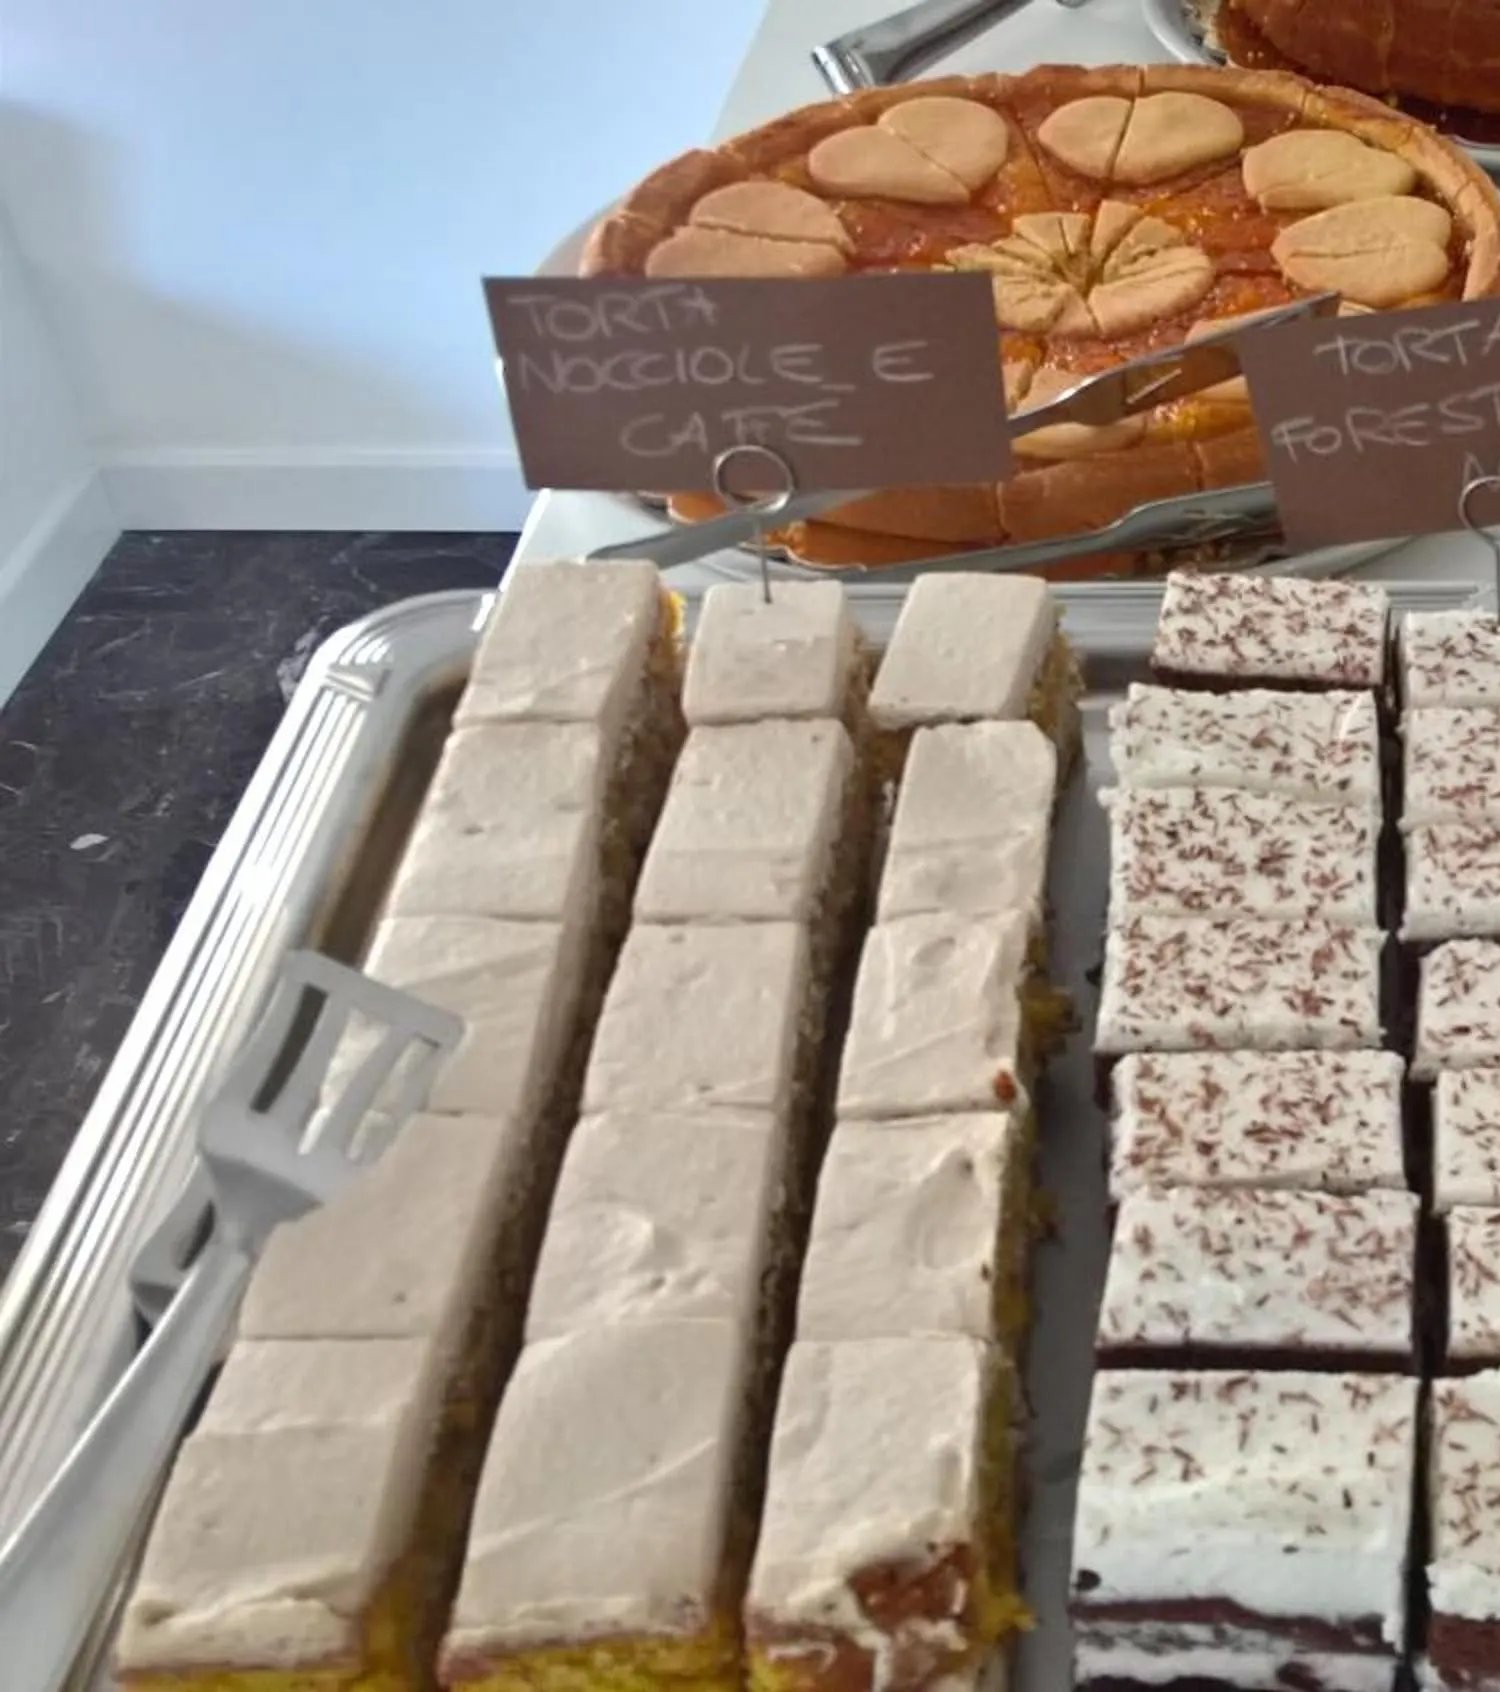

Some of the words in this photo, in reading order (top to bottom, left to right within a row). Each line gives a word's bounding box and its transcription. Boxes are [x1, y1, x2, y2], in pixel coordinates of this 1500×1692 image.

[508, 286, 718, 341] TORTA
[518, 343, 823, 393] NOCCIOLE
[872, 341, 932, 382] E
